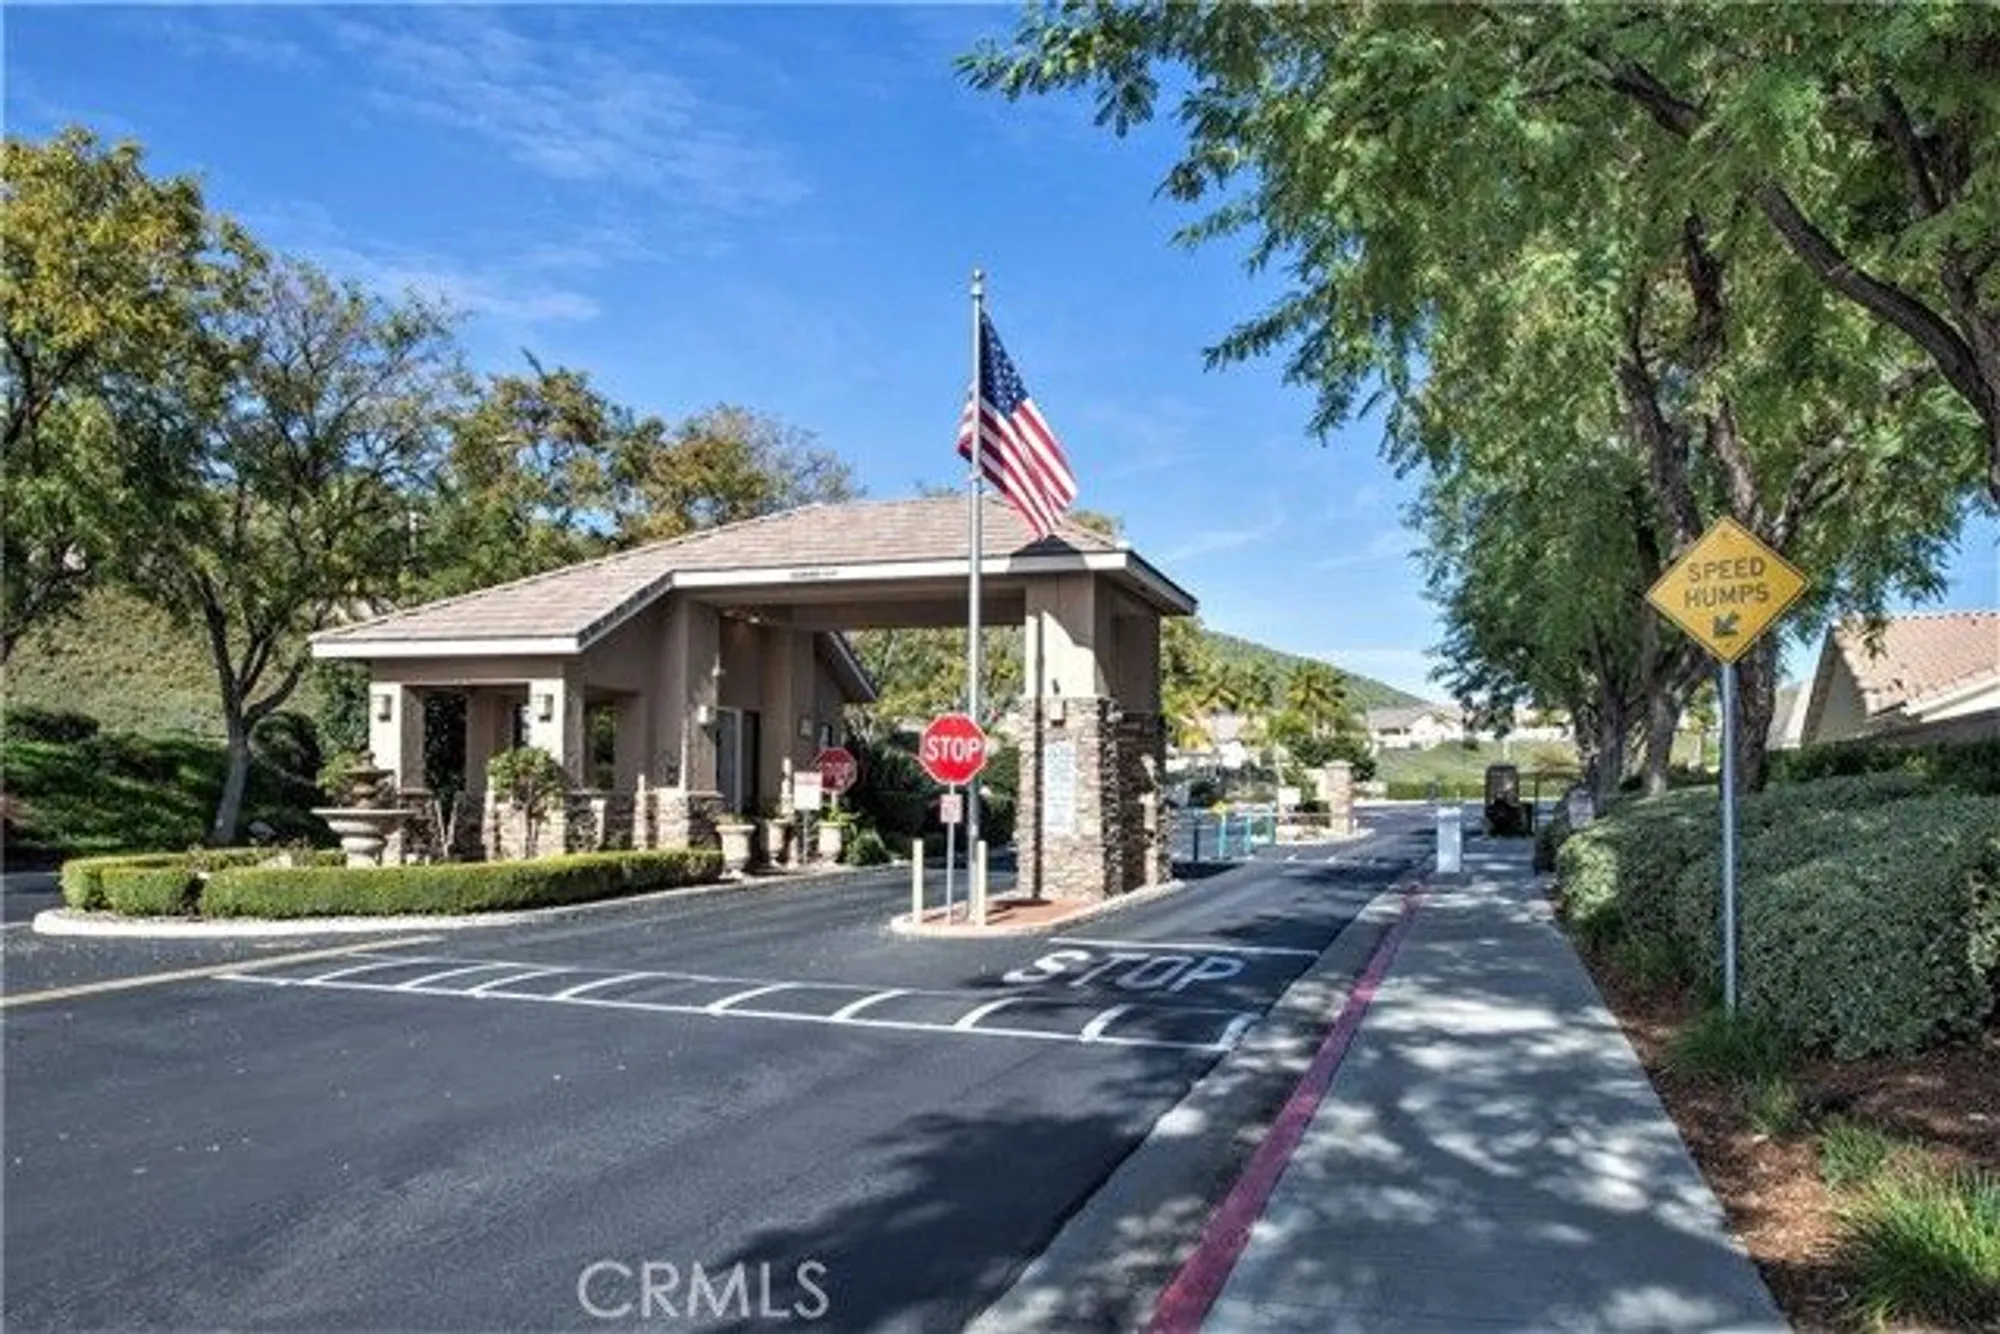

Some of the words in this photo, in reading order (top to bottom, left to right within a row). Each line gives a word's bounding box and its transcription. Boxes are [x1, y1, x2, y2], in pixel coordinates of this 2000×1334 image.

[1687, 556, 1766, 582] SPEED
[1684, 582, 1769, 608] HUMPS
[925, 735, 981, 763] STOP
[1003, 950, 1245, 992] STOP
